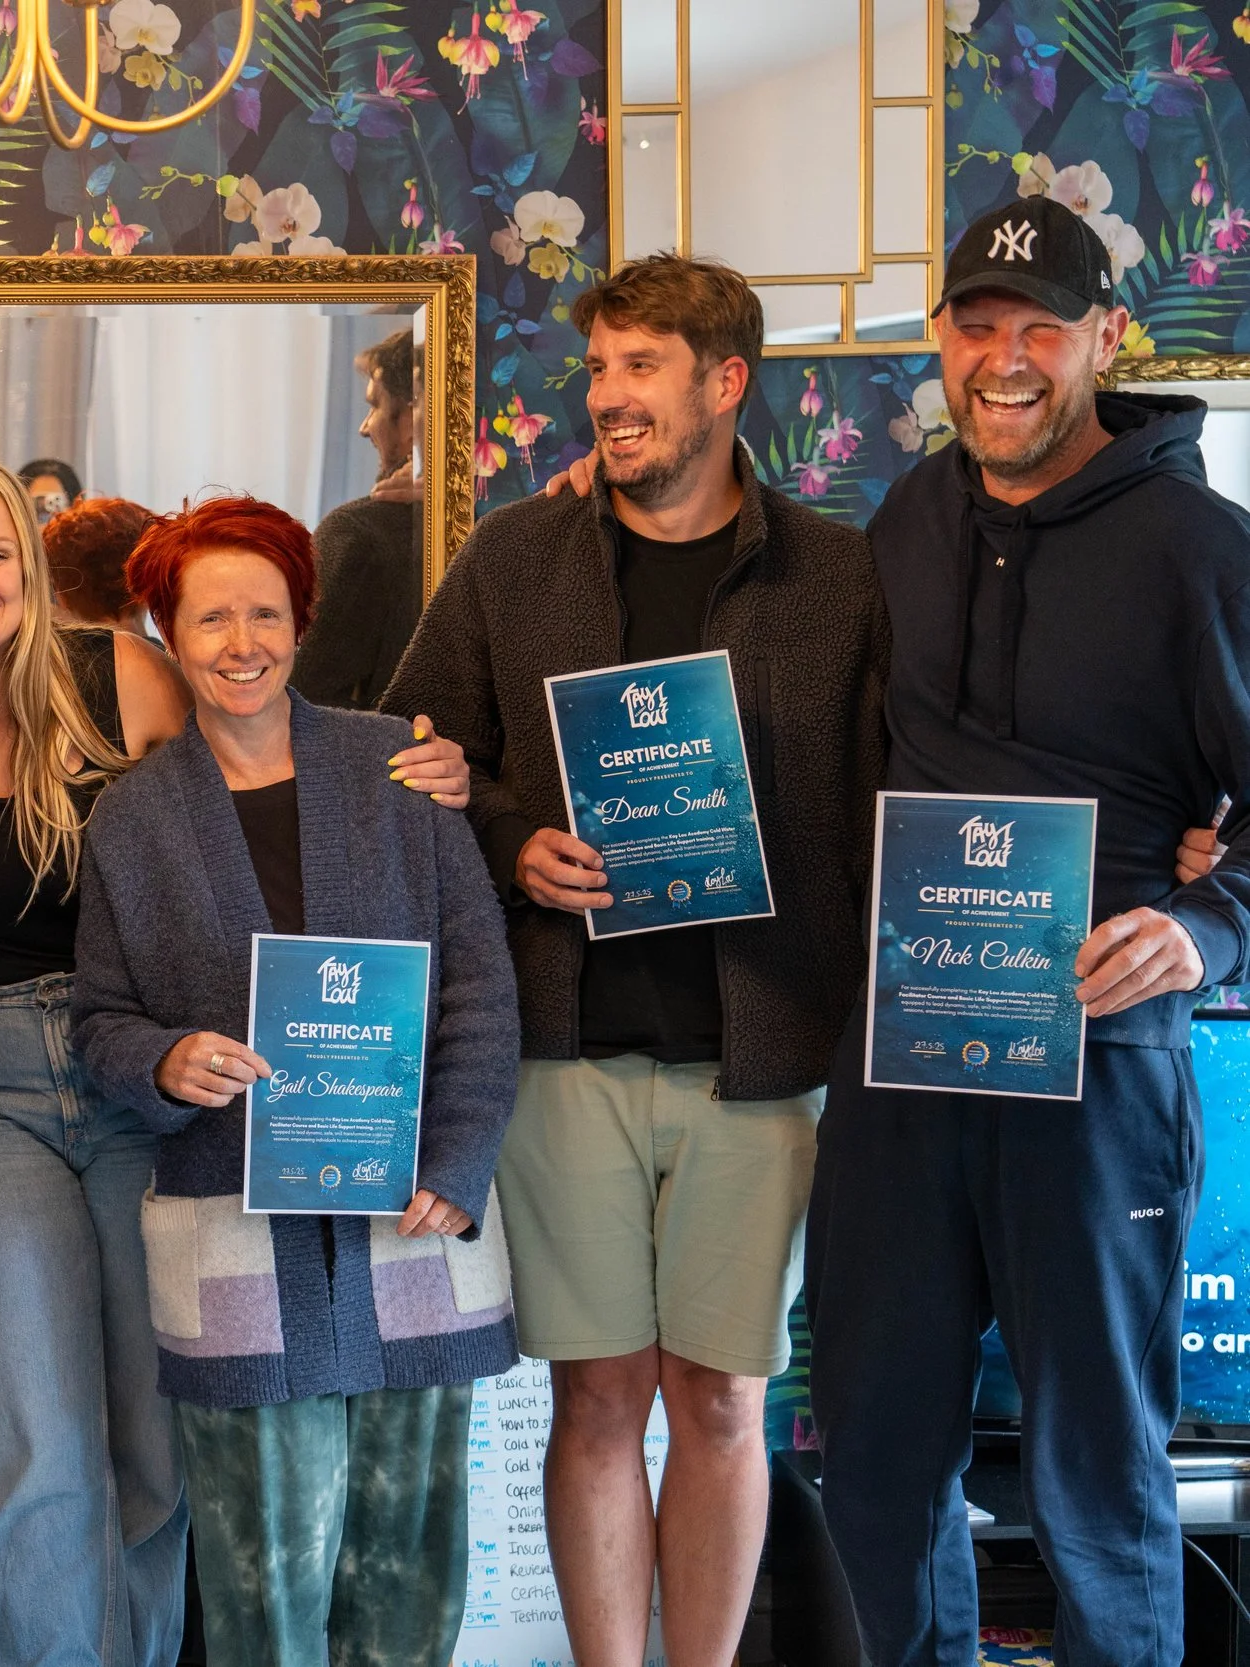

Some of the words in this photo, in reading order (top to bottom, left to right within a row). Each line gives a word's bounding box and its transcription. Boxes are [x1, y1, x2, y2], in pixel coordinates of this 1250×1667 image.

[988, 220, 1037, 261] NY
[996, 557, 1005, 566] H
[600, 738, 712, 768] CERTIFICATE
[646, 762, 679, 771] ACHIEVEMENT
[626, 776, 652, 784] PROUDLY
[653, 772, 684, 780] PRESENTED
[601, 796, 660, 824] Dean
[665, 786, 728, 816] Smith
[919, 885, 1052, 908] CERTIFICATE
[970, 909, 1009, 917] ACHIEVEMENT
[910, 936, 974, 968] Nick
[980, 940, 1052, 970] Culkin
[285, 1022, 392, 1041] CERTIFICATE
[267, 1070, 305, 1102] Gail
[308, 1072, 403, 1102] Shakespeare
[1130, 1208, 1164, 1220] HUGO
[495, 1376, 527, 1390] Basic
[498, 1396, 537, 1410] LUNCH
[504, 1438, 529, 1451] Cold
[505, 1458, 530, 1474] Cold
[506, 1483, 543, 1500] Coffee
